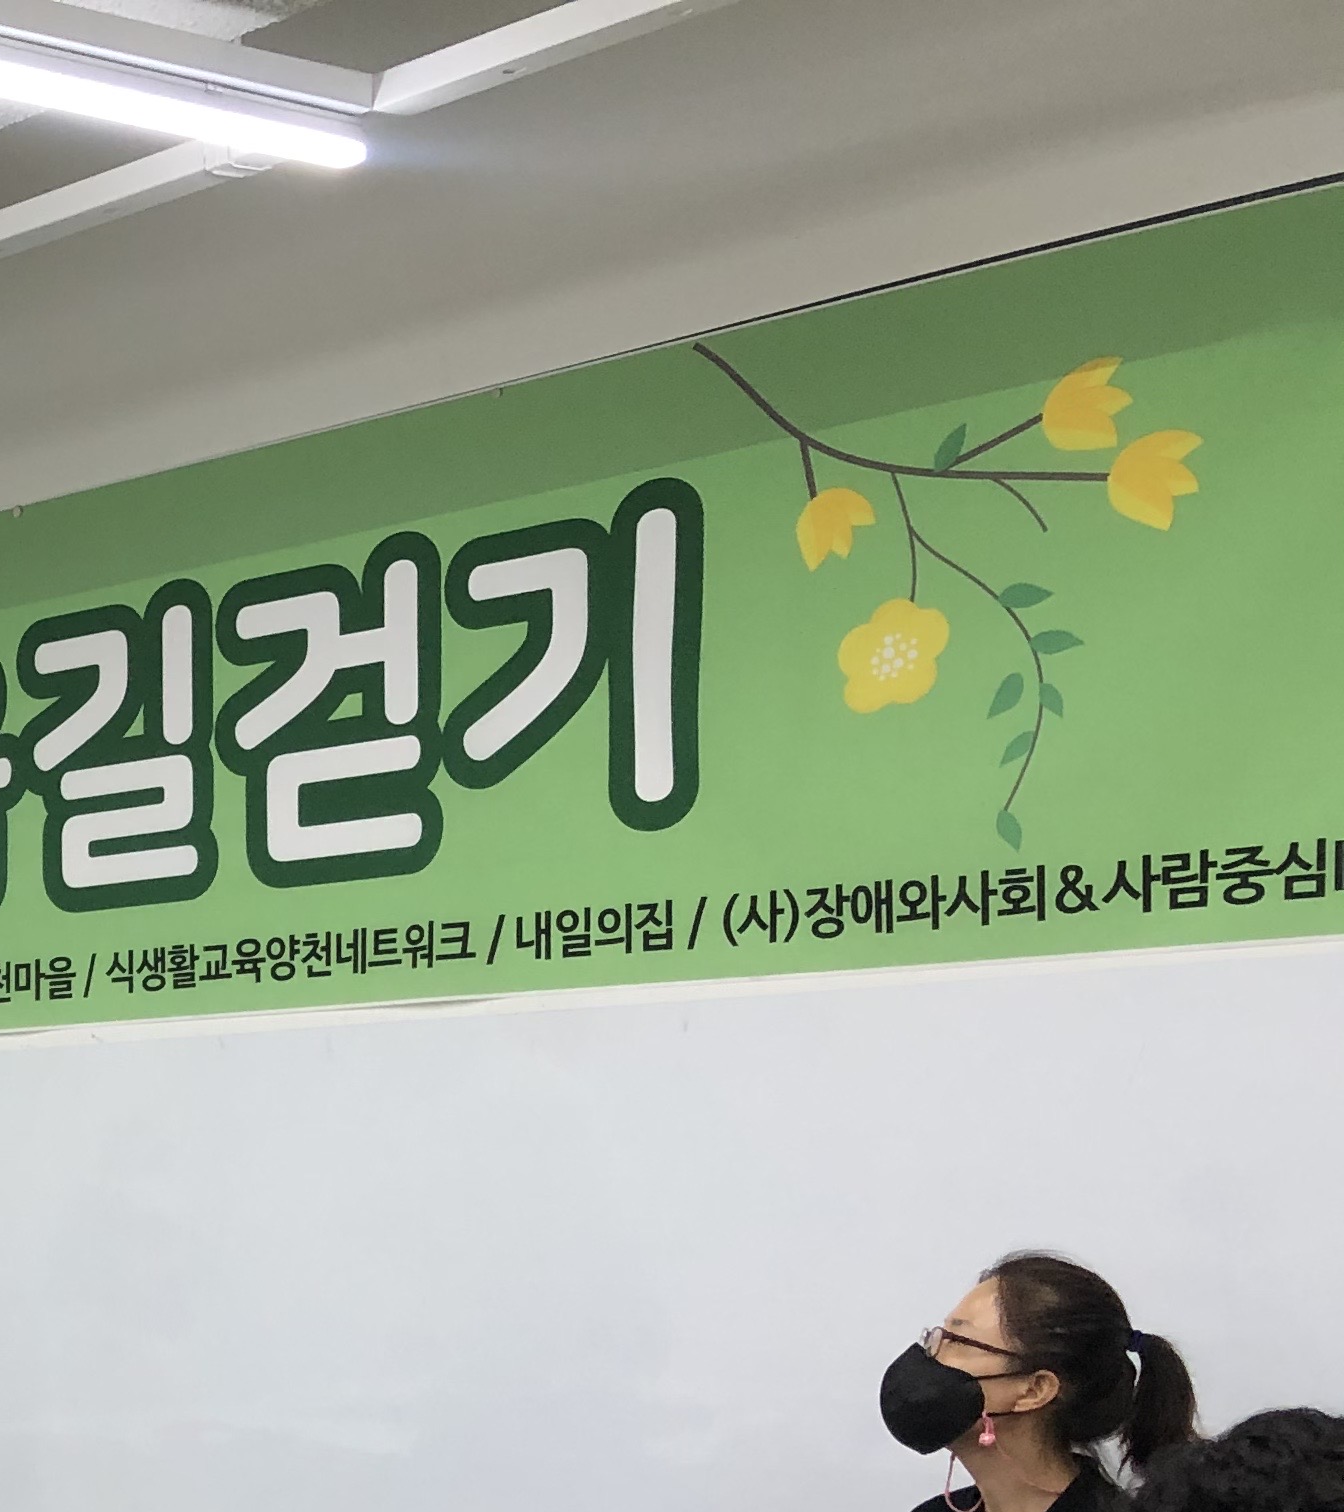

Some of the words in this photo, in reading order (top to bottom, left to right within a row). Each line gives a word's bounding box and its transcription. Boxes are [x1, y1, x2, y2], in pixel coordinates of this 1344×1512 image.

[105, 918, 477, 995] 식생활교육양천네트워크
[514, 897, 674, 961] 내일의집
[721, 838, 1344, 946] (사)장애와사회&사람중심
